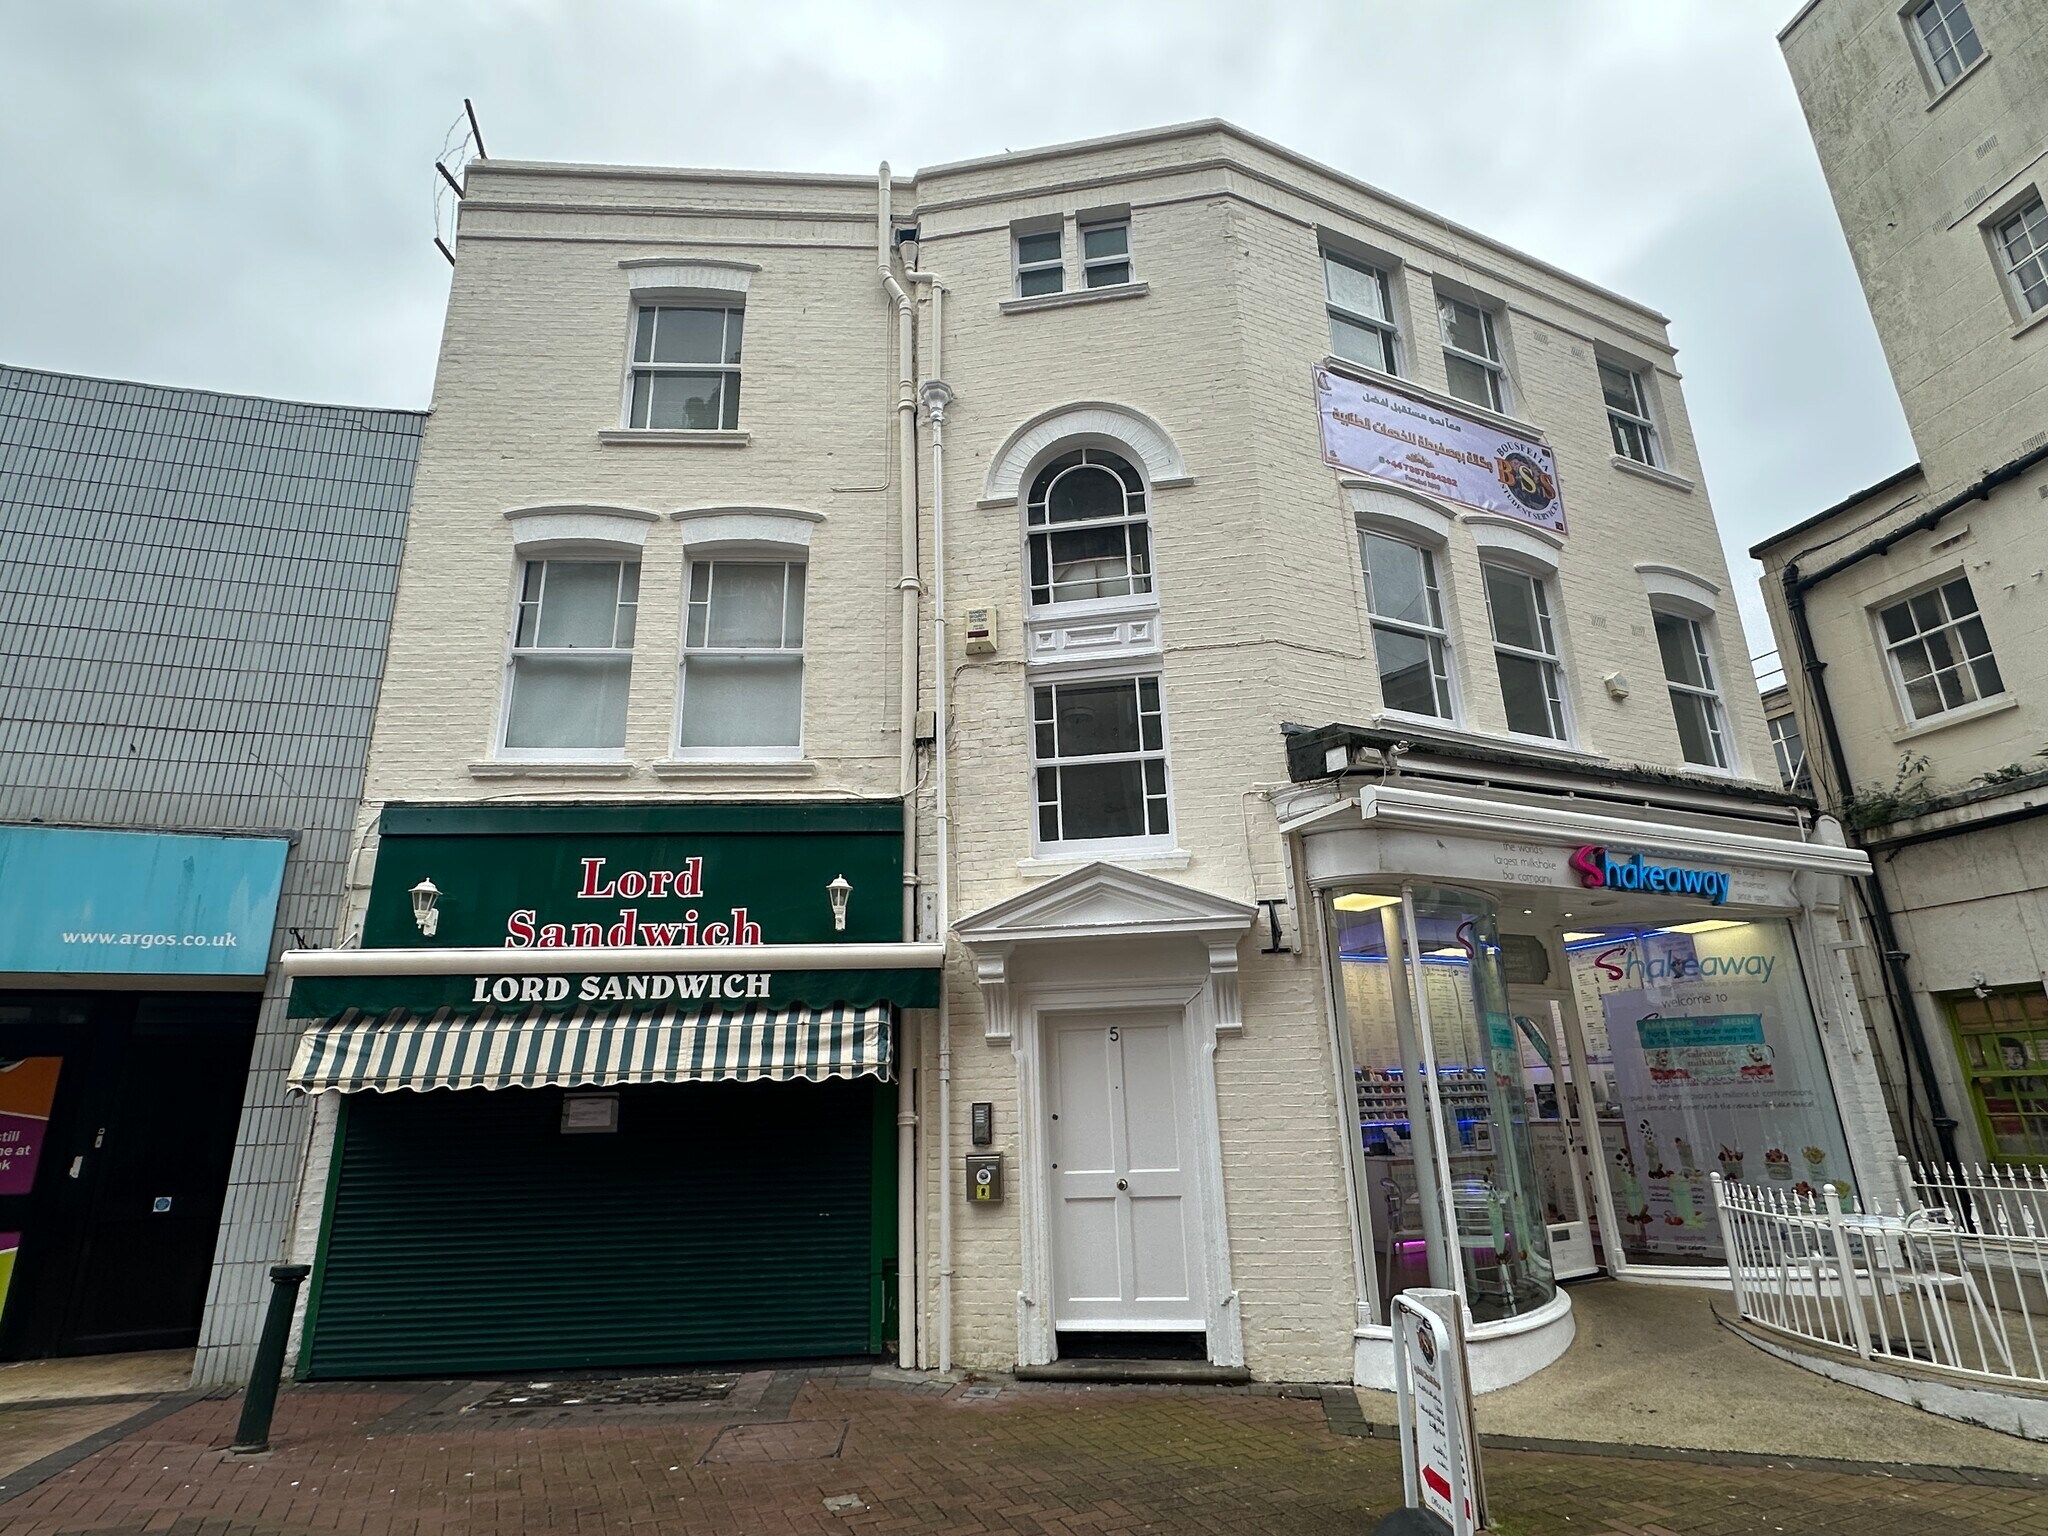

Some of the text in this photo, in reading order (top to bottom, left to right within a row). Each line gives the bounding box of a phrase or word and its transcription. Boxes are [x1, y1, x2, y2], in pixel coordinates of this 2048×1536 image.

[1494, 855, 1557, 871] largest milkshake
[577, 856, 703, 899] Lord
[1502, 869, 1552, 885] bar company
[1568, 844, 1730, 906] Shakeaway
[505, 908, 763, 948] Sandwich
[62, 932, 237, 949] www.argos.co.uk
[1594, 947, 1776, 984] Shakeaway
[472, 973, 771, 1003] LORD SANDWICH
[1661, 993, 1728, 1009] welcome to
[1109, 1026, 1119, 1042] 5
[0, 1130, 20, 1142] till
[16, 1145, 31, 1155] at
